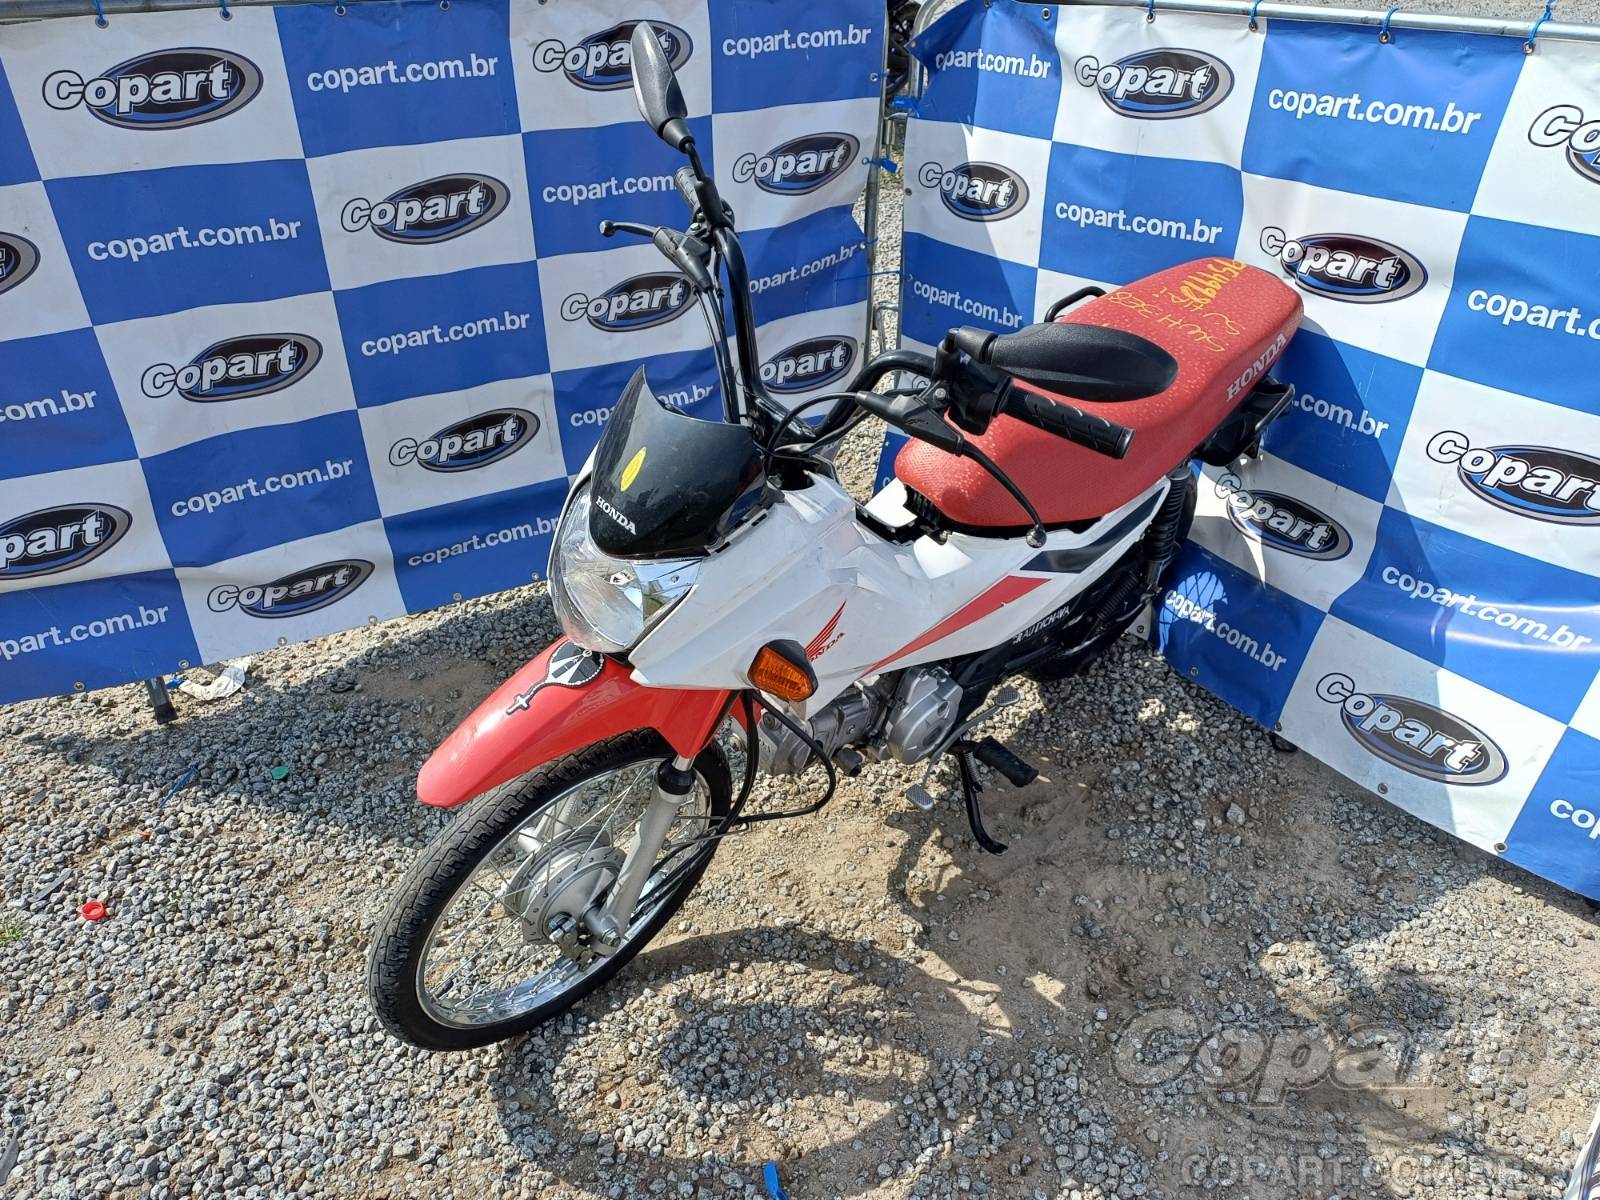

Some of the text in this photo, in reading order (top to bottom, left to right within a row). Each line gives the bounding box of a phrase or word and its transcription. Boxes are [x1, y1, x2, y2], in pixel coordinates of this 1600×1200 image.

[533, 31, 671, 79] Copat
[721, 24, 872, 57] copart.com.br
[42, 59, 232, 115] Copart
[306, 53, 498, 94] copart.com.br
[1074, 54, 1210, 101] Copart
[1268, 88, 1482, 134] copart.com.br
[1527, 104, 1600, 166] Co
[732, 137, 849, 184] Copart
[918, 160, 1014, 209] Copart
[341, 176, 488, 232] Copart
[542, 172, 676, 205] copart.com.
[87, 217, 302, 263] copart.com.br
[1055, 202, 1222, 244] copart.com.br
[749, 244, 857, 294] opart.com.br
[1259, 226, 1401, 290] Copart
[561, 275, 686, 323] Copart
[913, 279, 1022, 330] copart.com.br
[361, 311, 530, 357] copart.com.br
[141, 337, 298, 399] Copart
[760, 339, 848, 386] opart
[1226, 333, 1288, 402] HONDA
[389, 411, 519, 468] Copart
[170, 457, 354, 517] copart.com.br
[1214, 471, 1333, 551] Copart
[596, 495, 637, 536] HONDA
[207, 563, 354, 613] Copart
[1382, 565, 1593, 653] copart.com.br
[1165, 589, 1287, 672] copart.com.br
[1315, 672, 1485, 774] Copart
